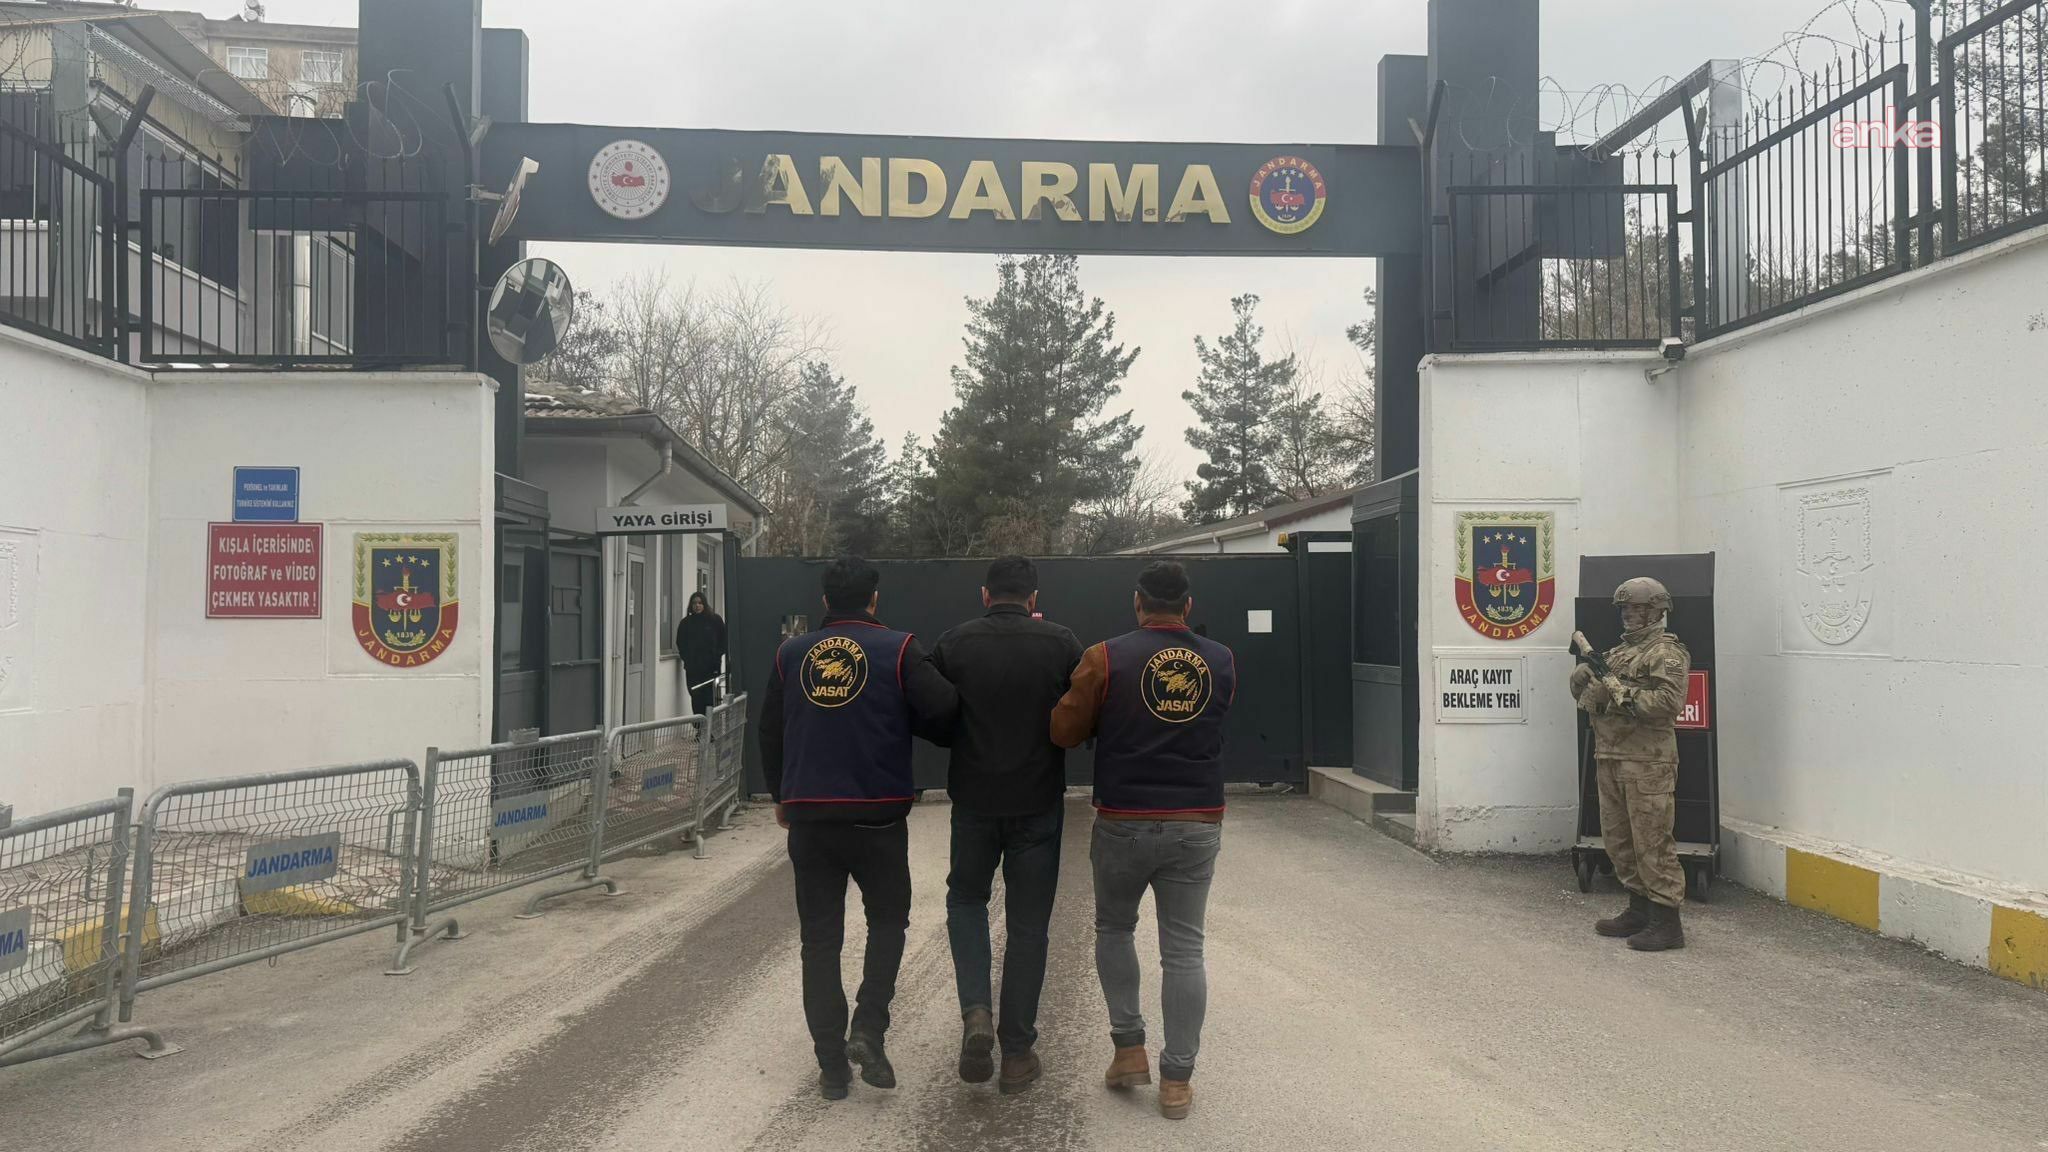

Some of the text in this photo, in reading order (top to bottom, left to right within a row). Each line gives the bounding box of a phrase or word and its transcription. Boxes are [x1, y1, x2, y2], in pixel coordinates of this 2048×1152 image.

[1254, 158, 1322, 189] JANDARMA
[613, 510, 712, 527] YAYA GİRİŞİ
[219, 533, 311, 555] KIŞLA İÇERİSİNDE
[213, 561, 316, 580] FOTOĞRAF ve VİDEO
[212, 591, 255, 608] ÇEKMEK
[258, 591, 309, 607] YASAKTIR
[1461, 603, 1550, 638] JANDARMA
[359, 628, 453, 665] JANDARMA
[809, 639, 864, 662] JANDARMA
[1149, 650, 1207, 674] JANDARMA
[1450, 669, 1512, 688] ARAÇ KAYIT
[812, 686, 849, 697] JASAT
[1443, 689, 1520, 708] BEKLEME YERİ
[1157, 699, 1196, 712] JASAT
[495, 803, 547, 827] JANDARMA
[248, 846, 333, 877] JANDARMA
